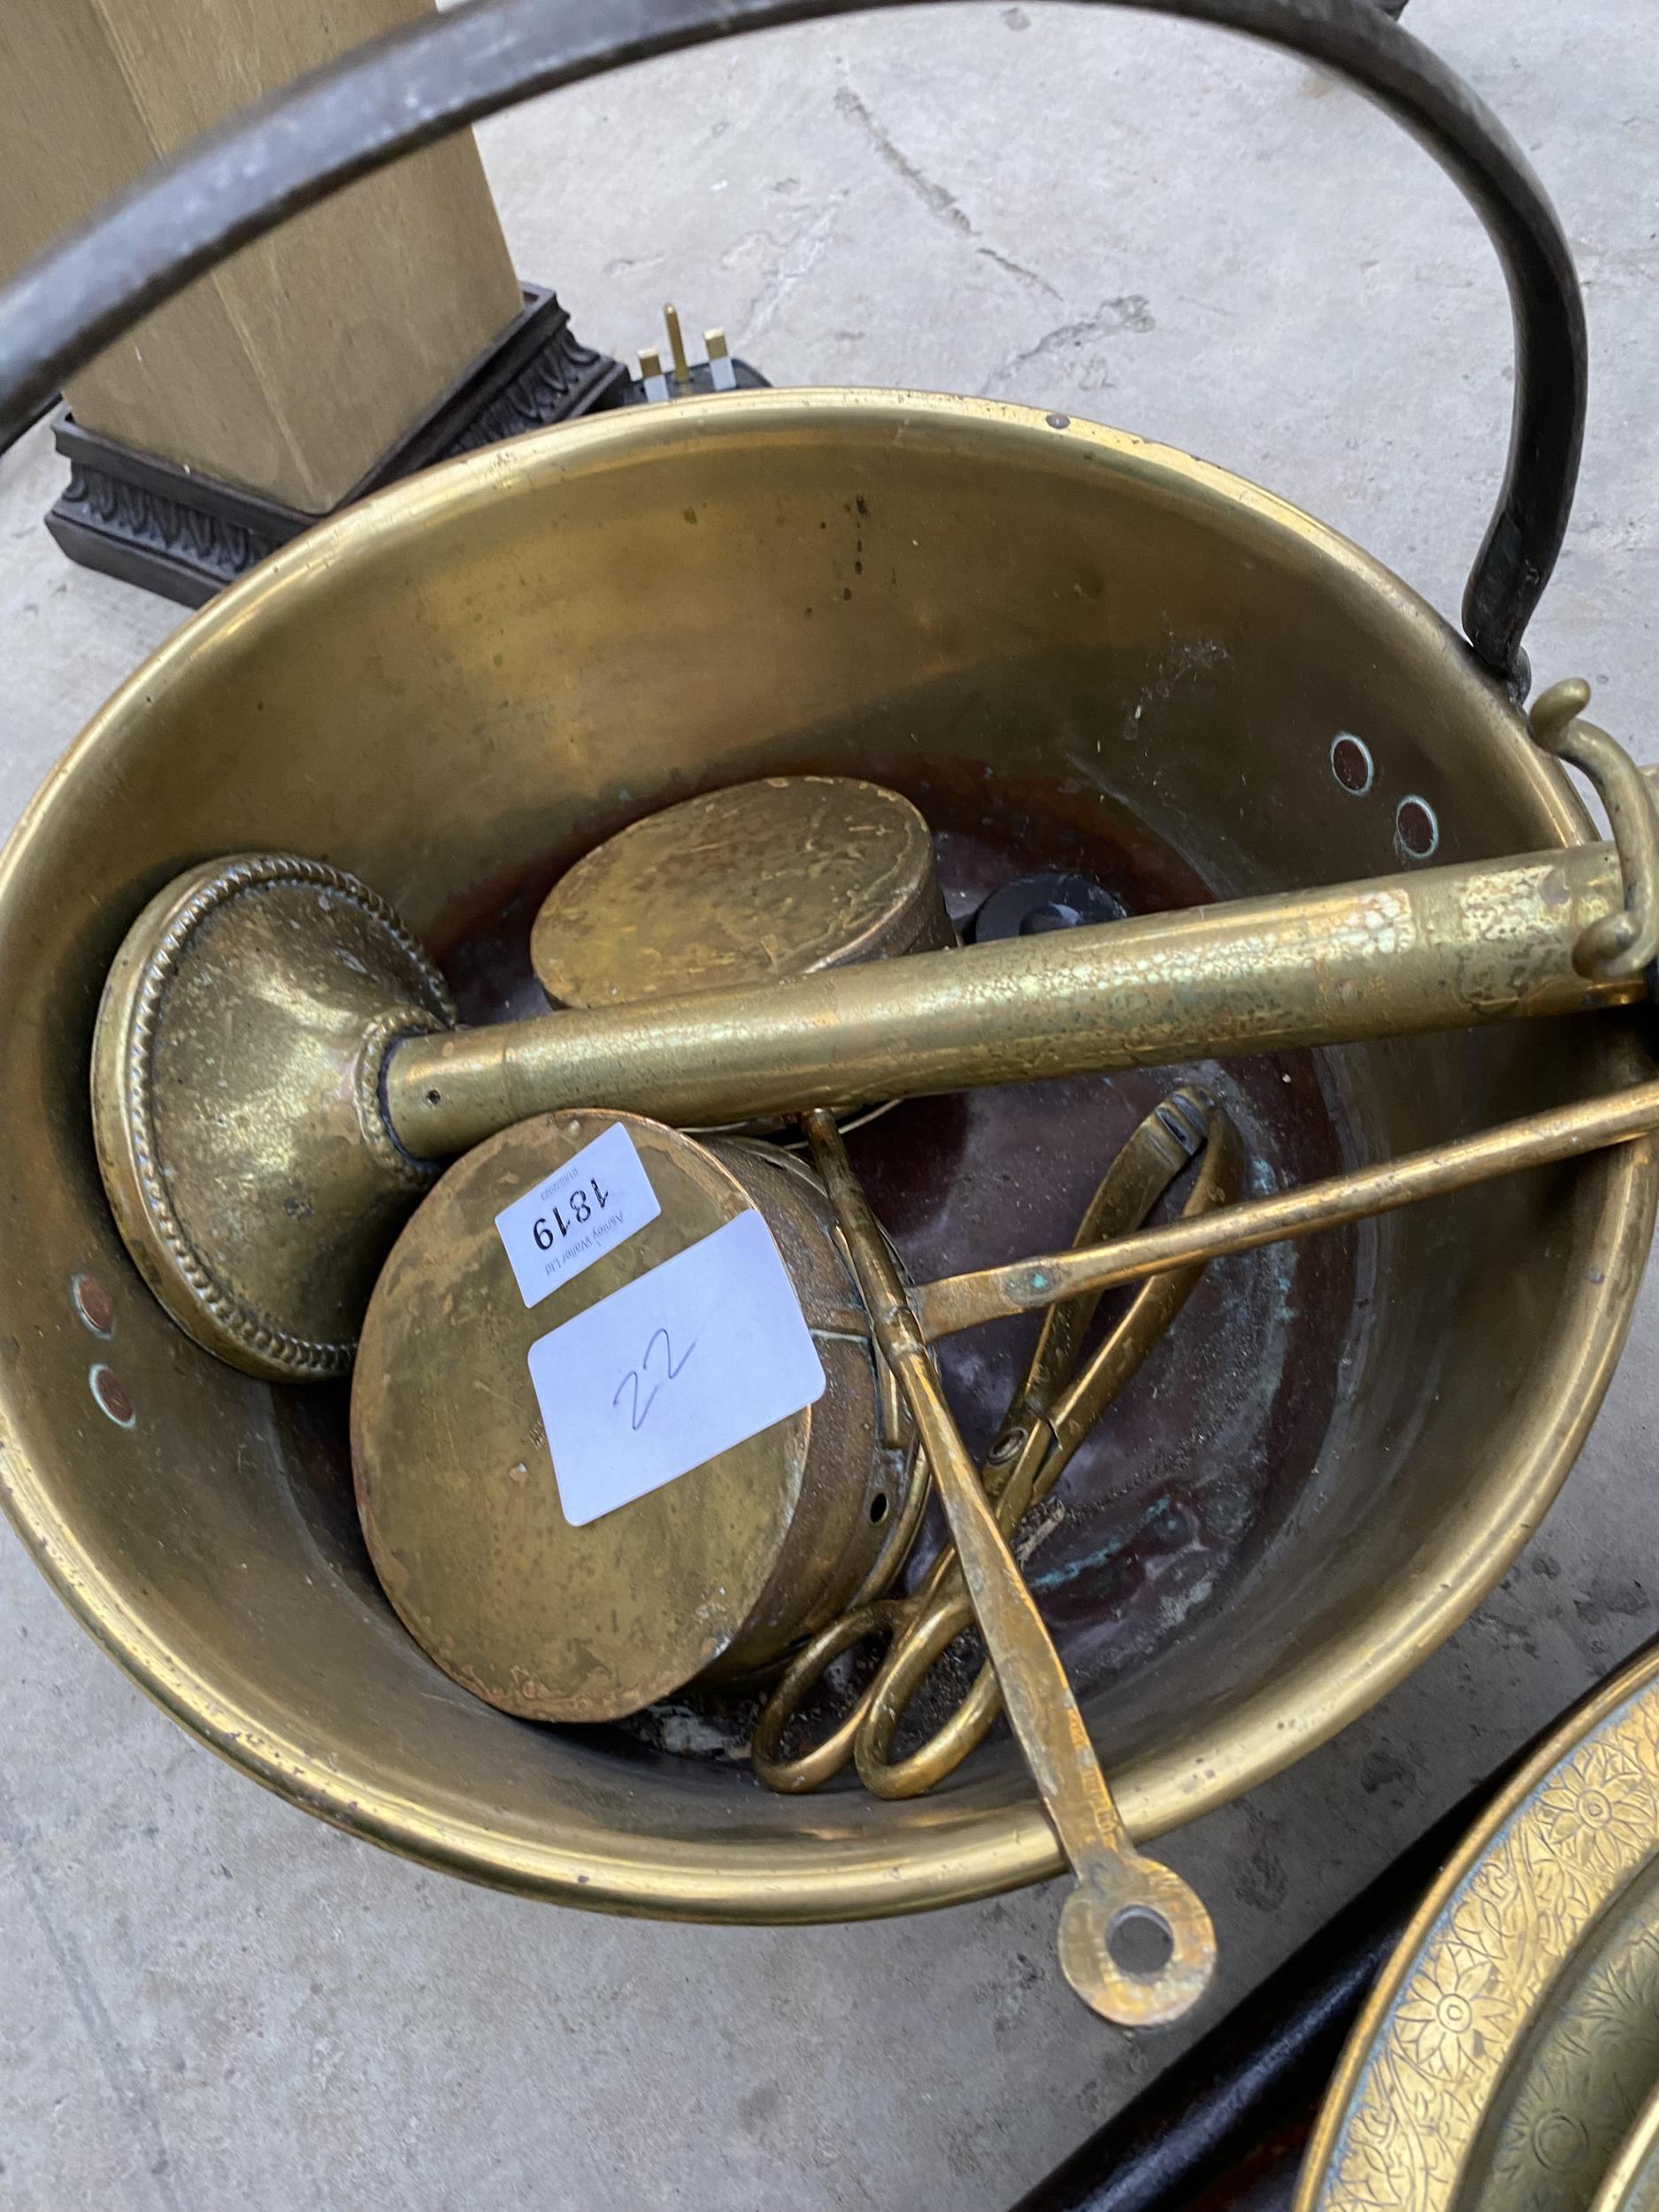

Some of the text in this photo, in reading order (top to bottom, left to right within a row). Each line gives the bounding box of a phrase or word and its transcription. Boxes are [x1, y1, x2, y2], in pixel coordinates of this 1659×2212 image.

[533, 1178, 610, 1251] 1819
[544, 1260, 563, 1277] Ltd
[562, 1236, 593, 1266] Waller
[612, 1327, 697, 1431] 22
